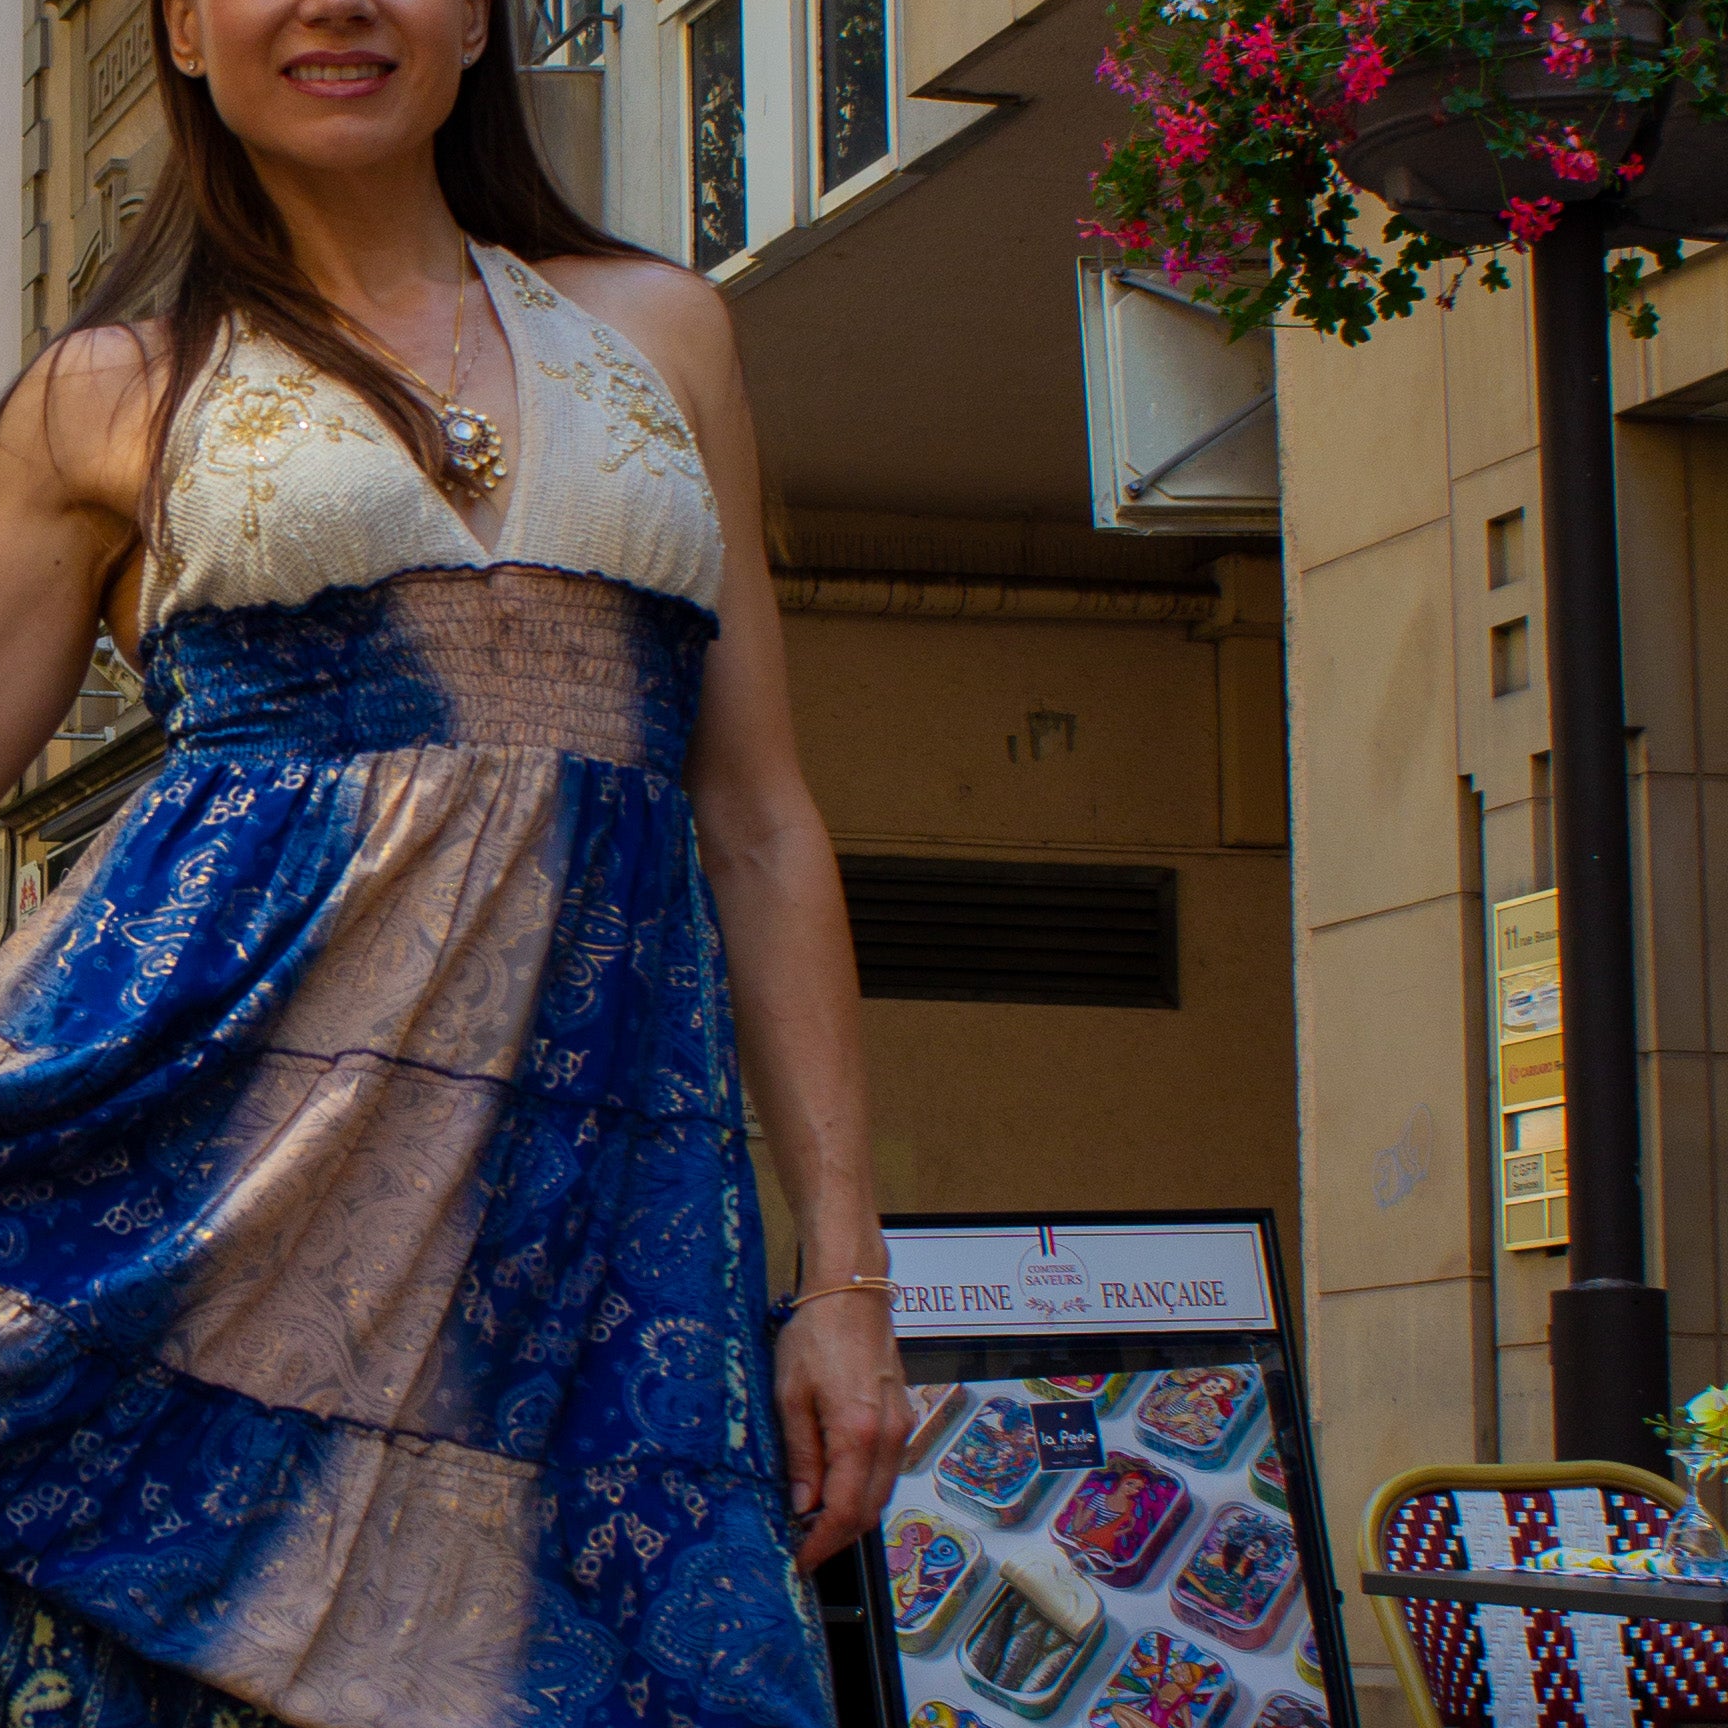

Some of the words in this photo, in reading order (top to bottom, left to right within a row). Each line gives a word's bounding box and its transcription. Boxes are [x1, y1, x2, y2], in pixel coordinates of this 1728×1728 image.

[1504, 924, 1520, 951] 11
[1024, 1274, 1084, 1286] SAVEURS
[959, 1284, 1013, 1312] FINE
[1100, 1280, 1227, 1314] FRANÇAISE
[1039, 1431, 1056, 1446] la
[1058, 1428, 1096, 1445] Perle
